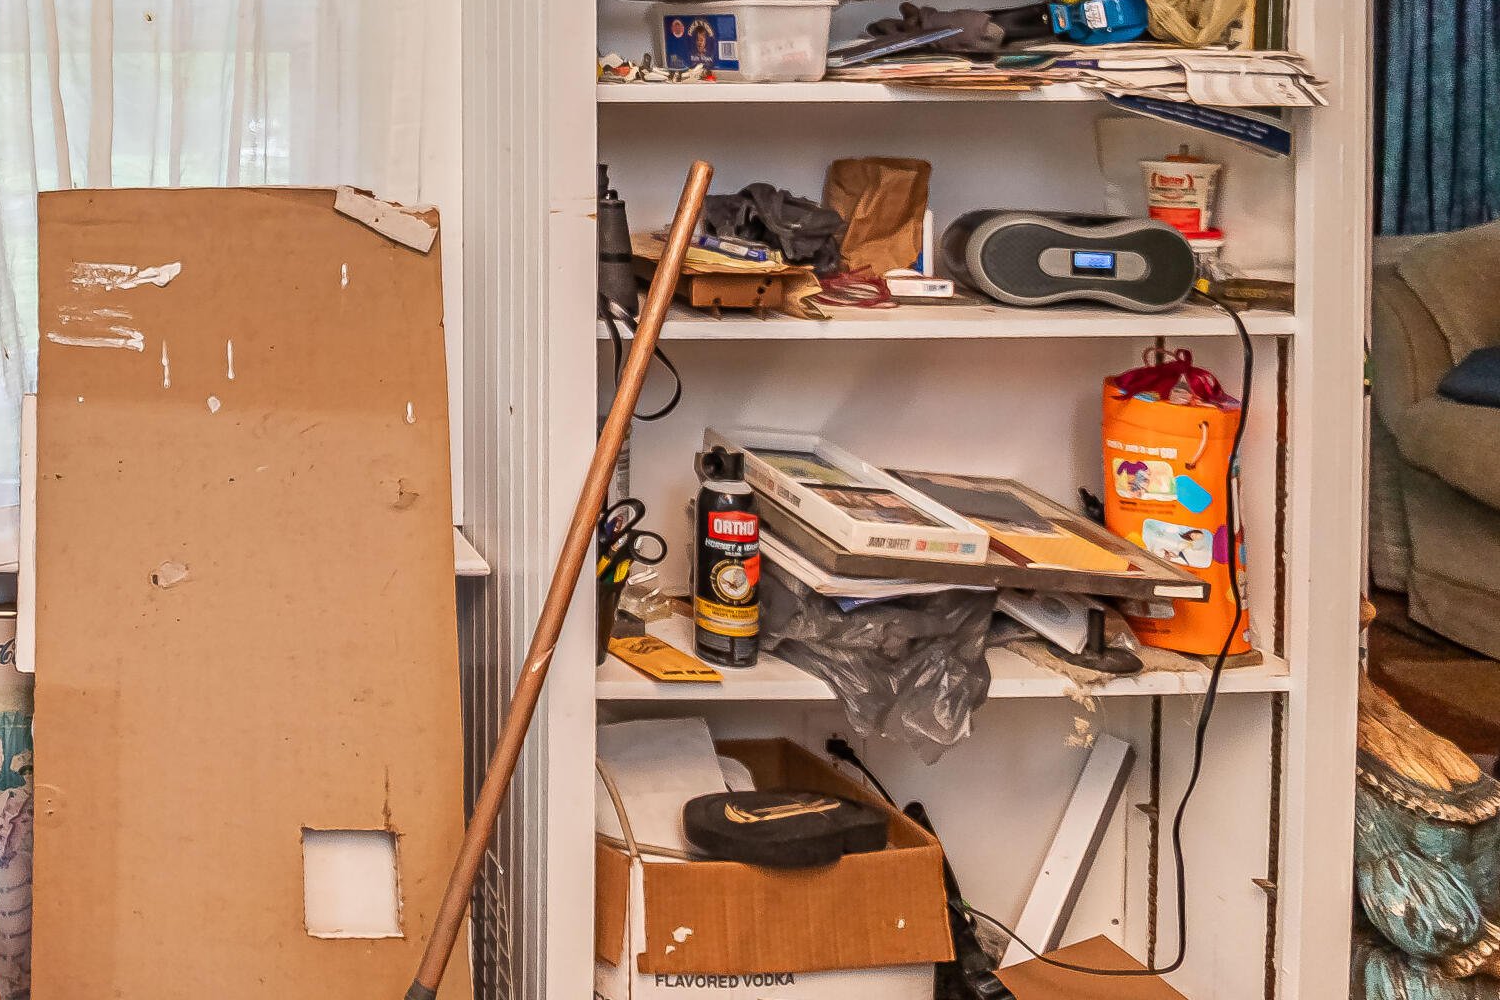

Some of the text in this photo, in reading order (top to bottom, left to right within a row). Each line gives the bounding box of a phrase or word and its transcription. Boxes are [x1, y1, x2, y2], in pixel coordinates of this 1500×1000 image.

[713, 518, 756, 537] ORTHO
[654, 971, 797, 989] FLAVORED VODKA
